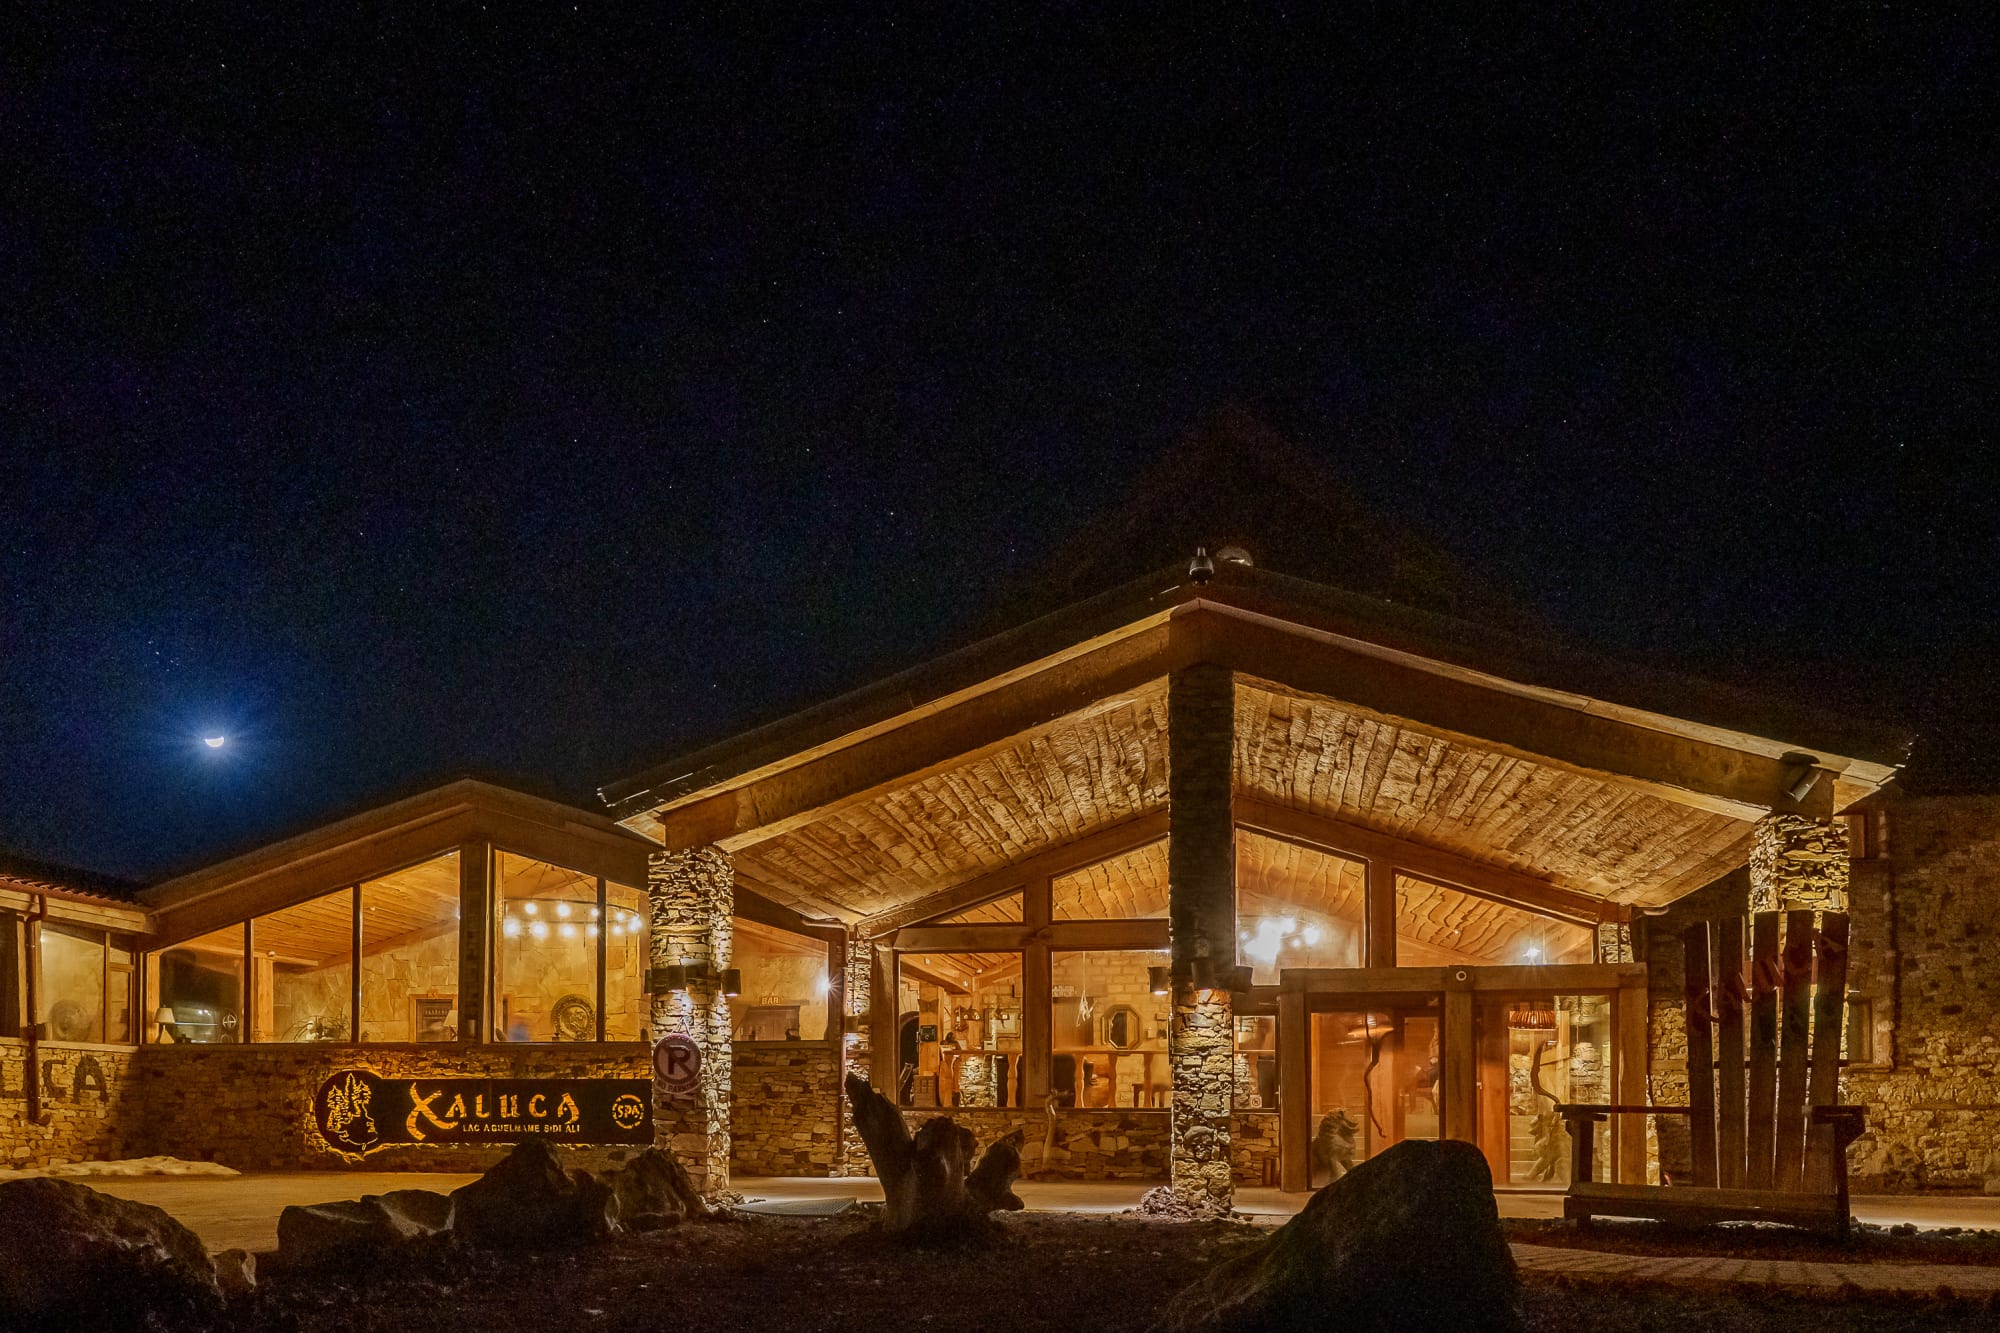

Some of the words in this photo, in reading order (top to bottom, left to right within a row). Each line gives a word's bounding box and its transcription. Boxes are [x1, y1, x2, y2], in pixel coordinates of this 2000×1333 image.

[761, 995, 780, 1005] BAR
[406, 1082, 580, 1141] XALUCA
[617, 1104, 641, 1118] SPA
[462, 1123, 480, 1133] LAC
[544, 1124, 562, 1133] SIDI
[565, 1124, 580, 1133] ALI
